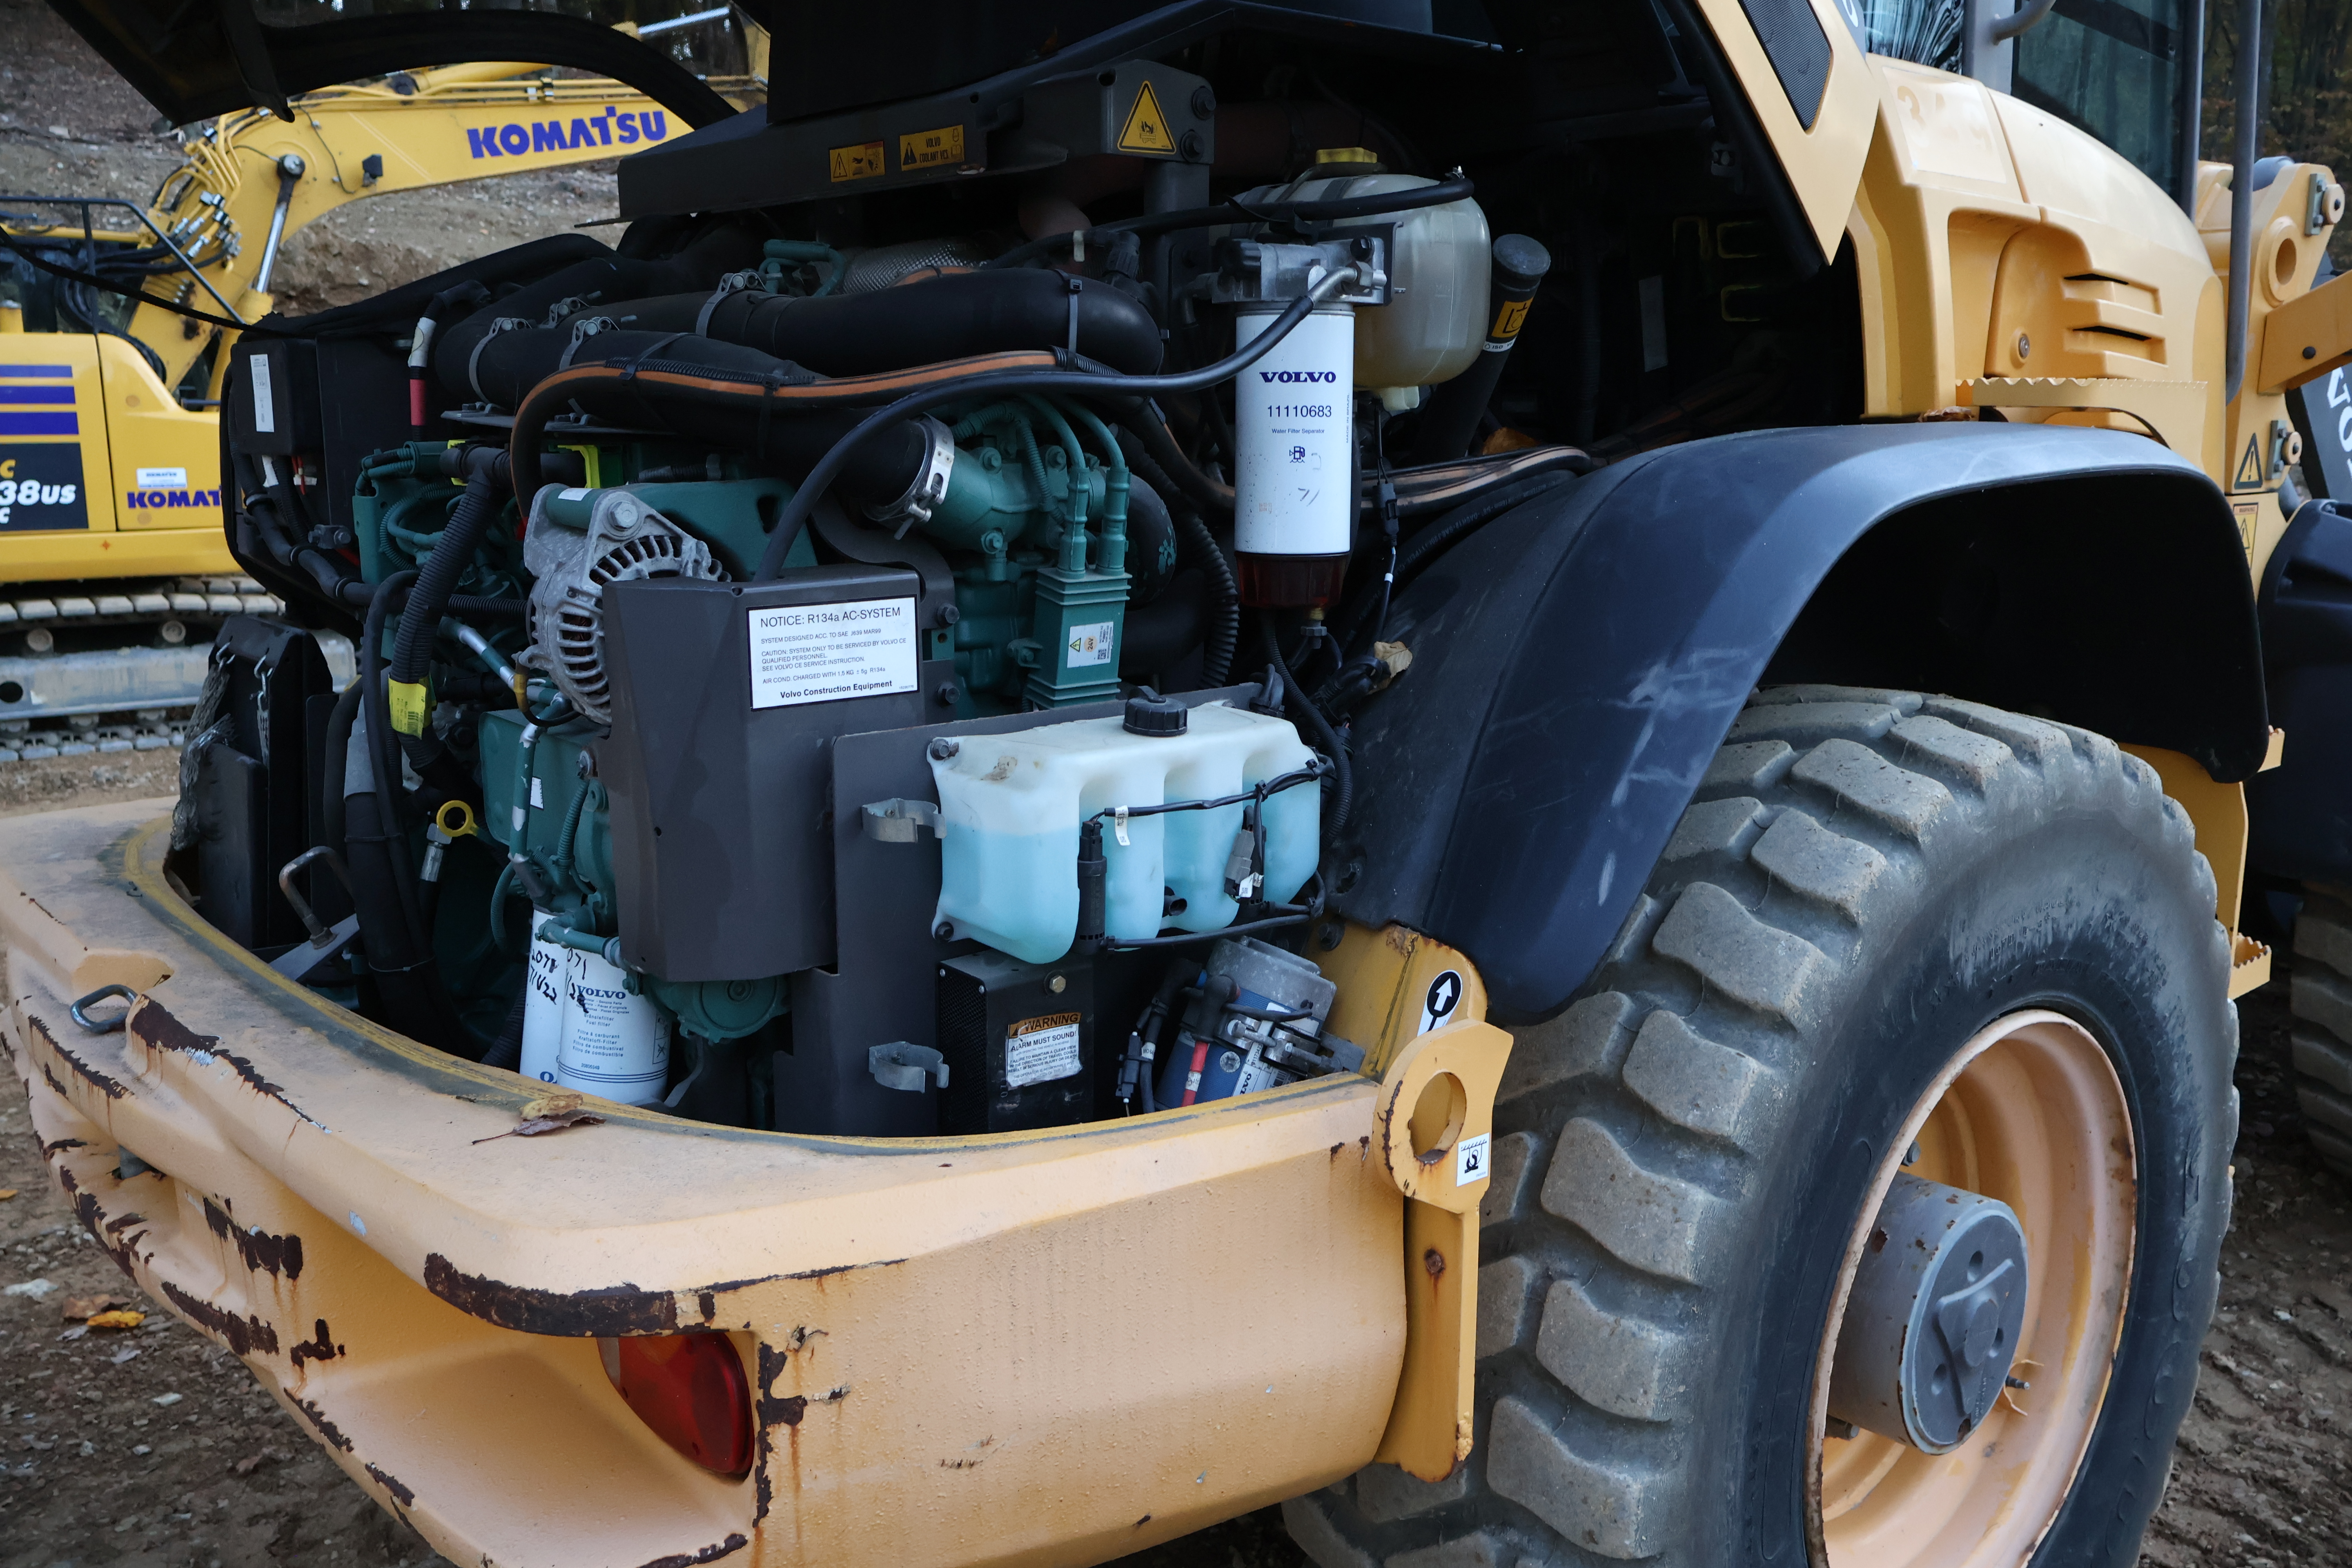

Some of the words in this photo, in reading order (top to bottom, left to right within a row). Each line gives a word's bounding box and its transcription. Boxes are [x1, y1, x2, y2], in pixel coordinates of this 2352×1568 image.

[467, 106, 668, 159] KOMATSU
[926, 136, 940, 148] VOLVO
[920, 151, 938, 163] COOLANT
[1259, 371, 1336, 383] VOLVO
[1267, 405, 1332, 417] 11110683
[761, 615, 804, 628] NOTICE:
[808, 613, 840, 624] R134a
[842, 606, 900, 621] AC-SYSTEM
[784, 634, 814, 642] DESIGNED
[845, 641, 871, 649] SERVICED
[792, 653, 828, 661] PERSONNEL.
[828, 656, 865, 665] INSTRUCTION.
[780, 690, 801, 698] Volvo
[804, 684, 851, 695] Construction
[853, 680, 893, 691] Equipment
[576, 985, 626, 999] VOLVO
[1024, 1013, 1079, 1032] WARNING
[579, 1036, 618, 1045] Kraftstoff-Filter
[1011, 1040, 1031, 1052] ALARM
[1033, 1036, 1050, 1045] MUST
[1052, 1030, 1076, 1041] SOUND!
[1022, 1057, 1042, 1065] DIRECTION
